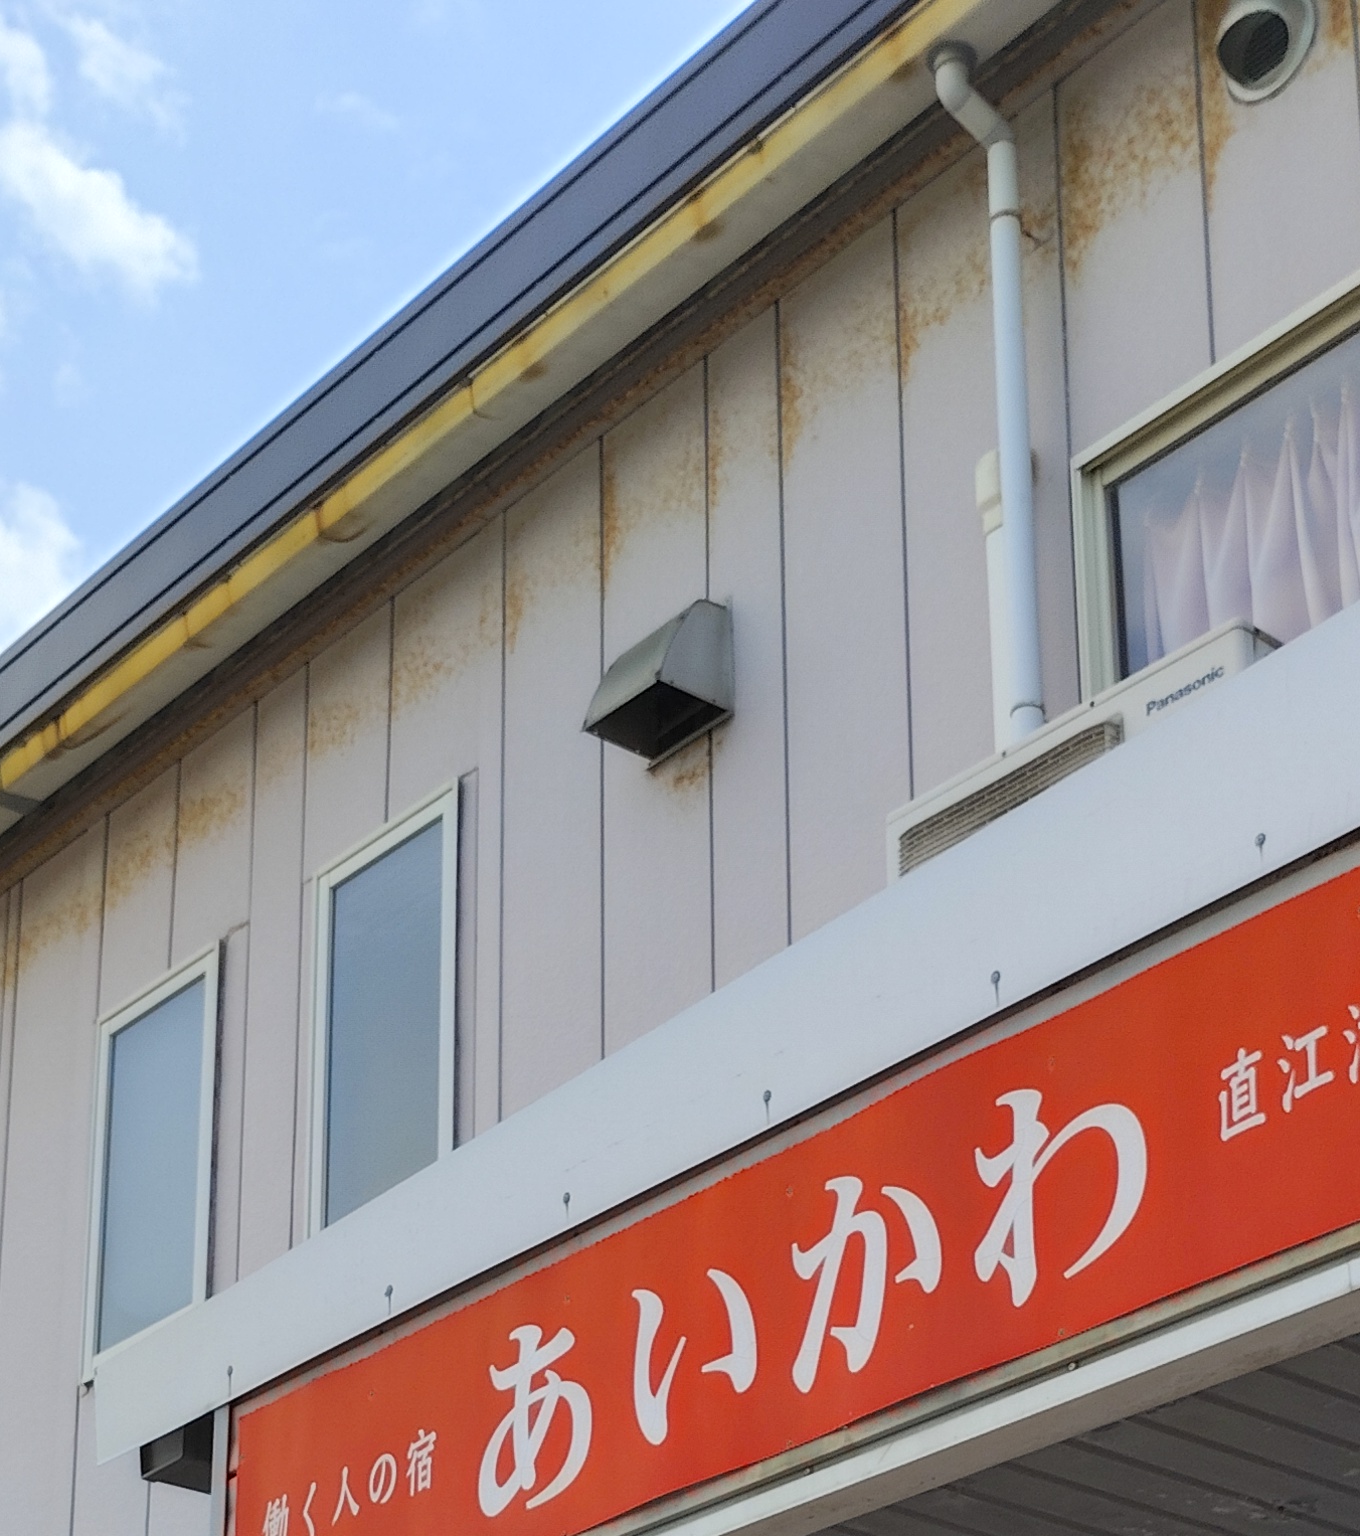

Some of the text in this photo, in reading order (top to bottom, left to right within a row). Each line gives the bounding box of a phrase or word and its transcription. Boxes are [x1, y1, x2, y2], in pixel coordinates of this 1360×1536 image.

[1146, 665, 1225, 716] Panasonic
[476, 1087, 1150, 1519] あいかわ
